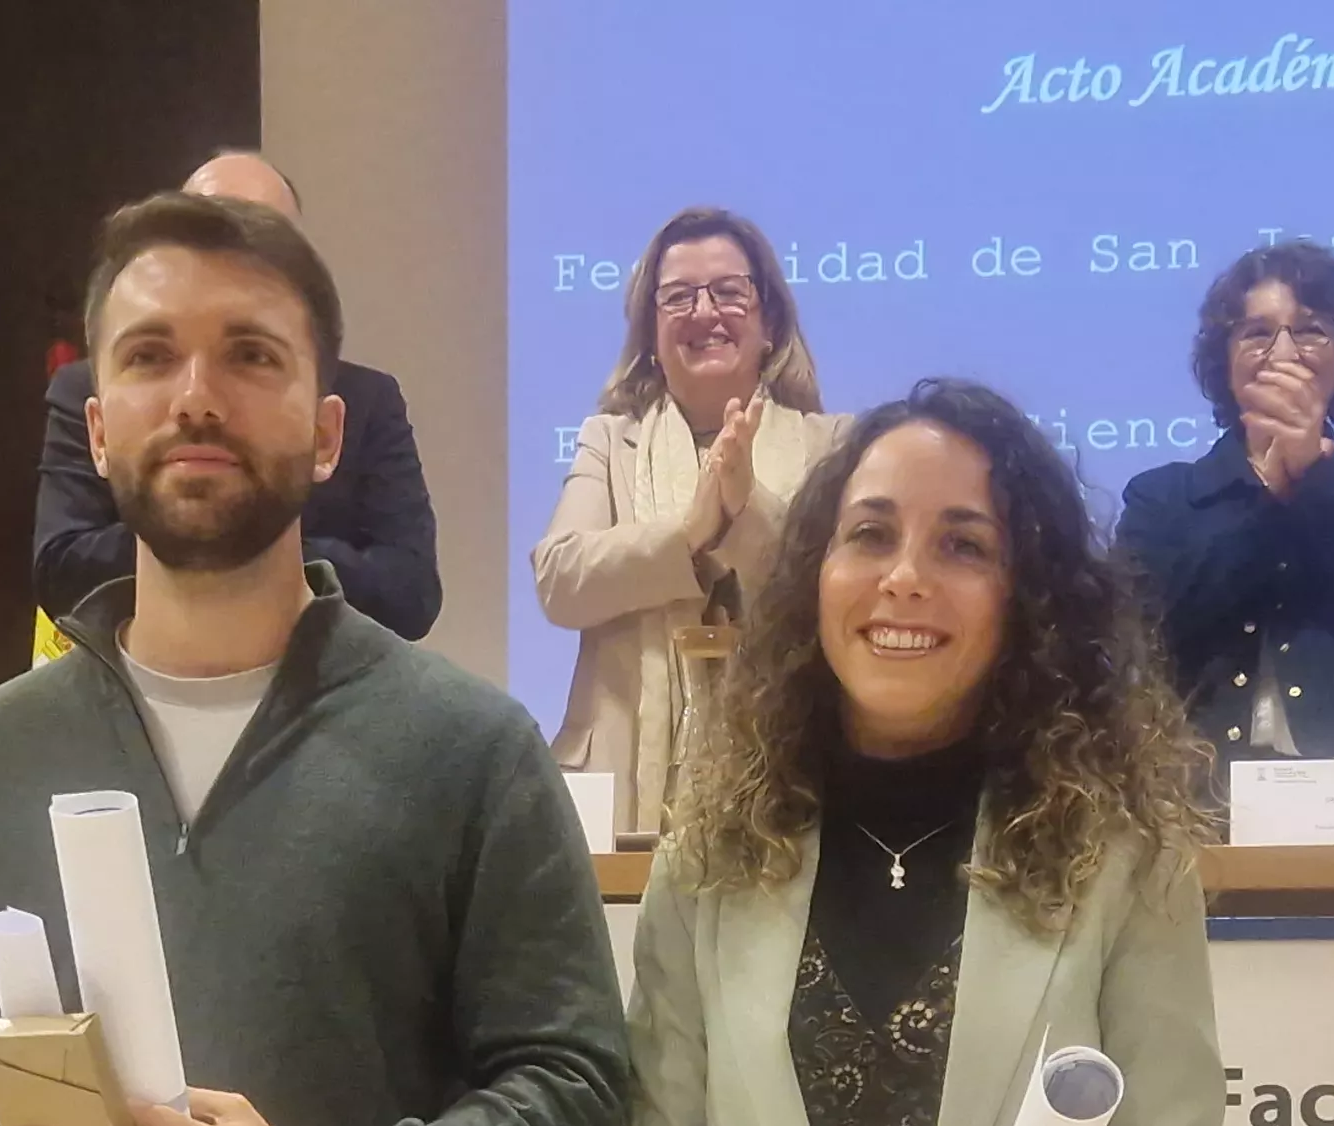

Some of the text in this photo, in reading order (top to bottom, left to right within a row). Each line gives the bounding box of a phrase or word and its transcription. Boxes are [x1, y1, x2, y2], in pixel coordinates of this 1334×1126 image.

[980, 51, 1122, 114] Acto
[971, 236, 1042, 278] de
[1089, 234, 1200, 273] San
